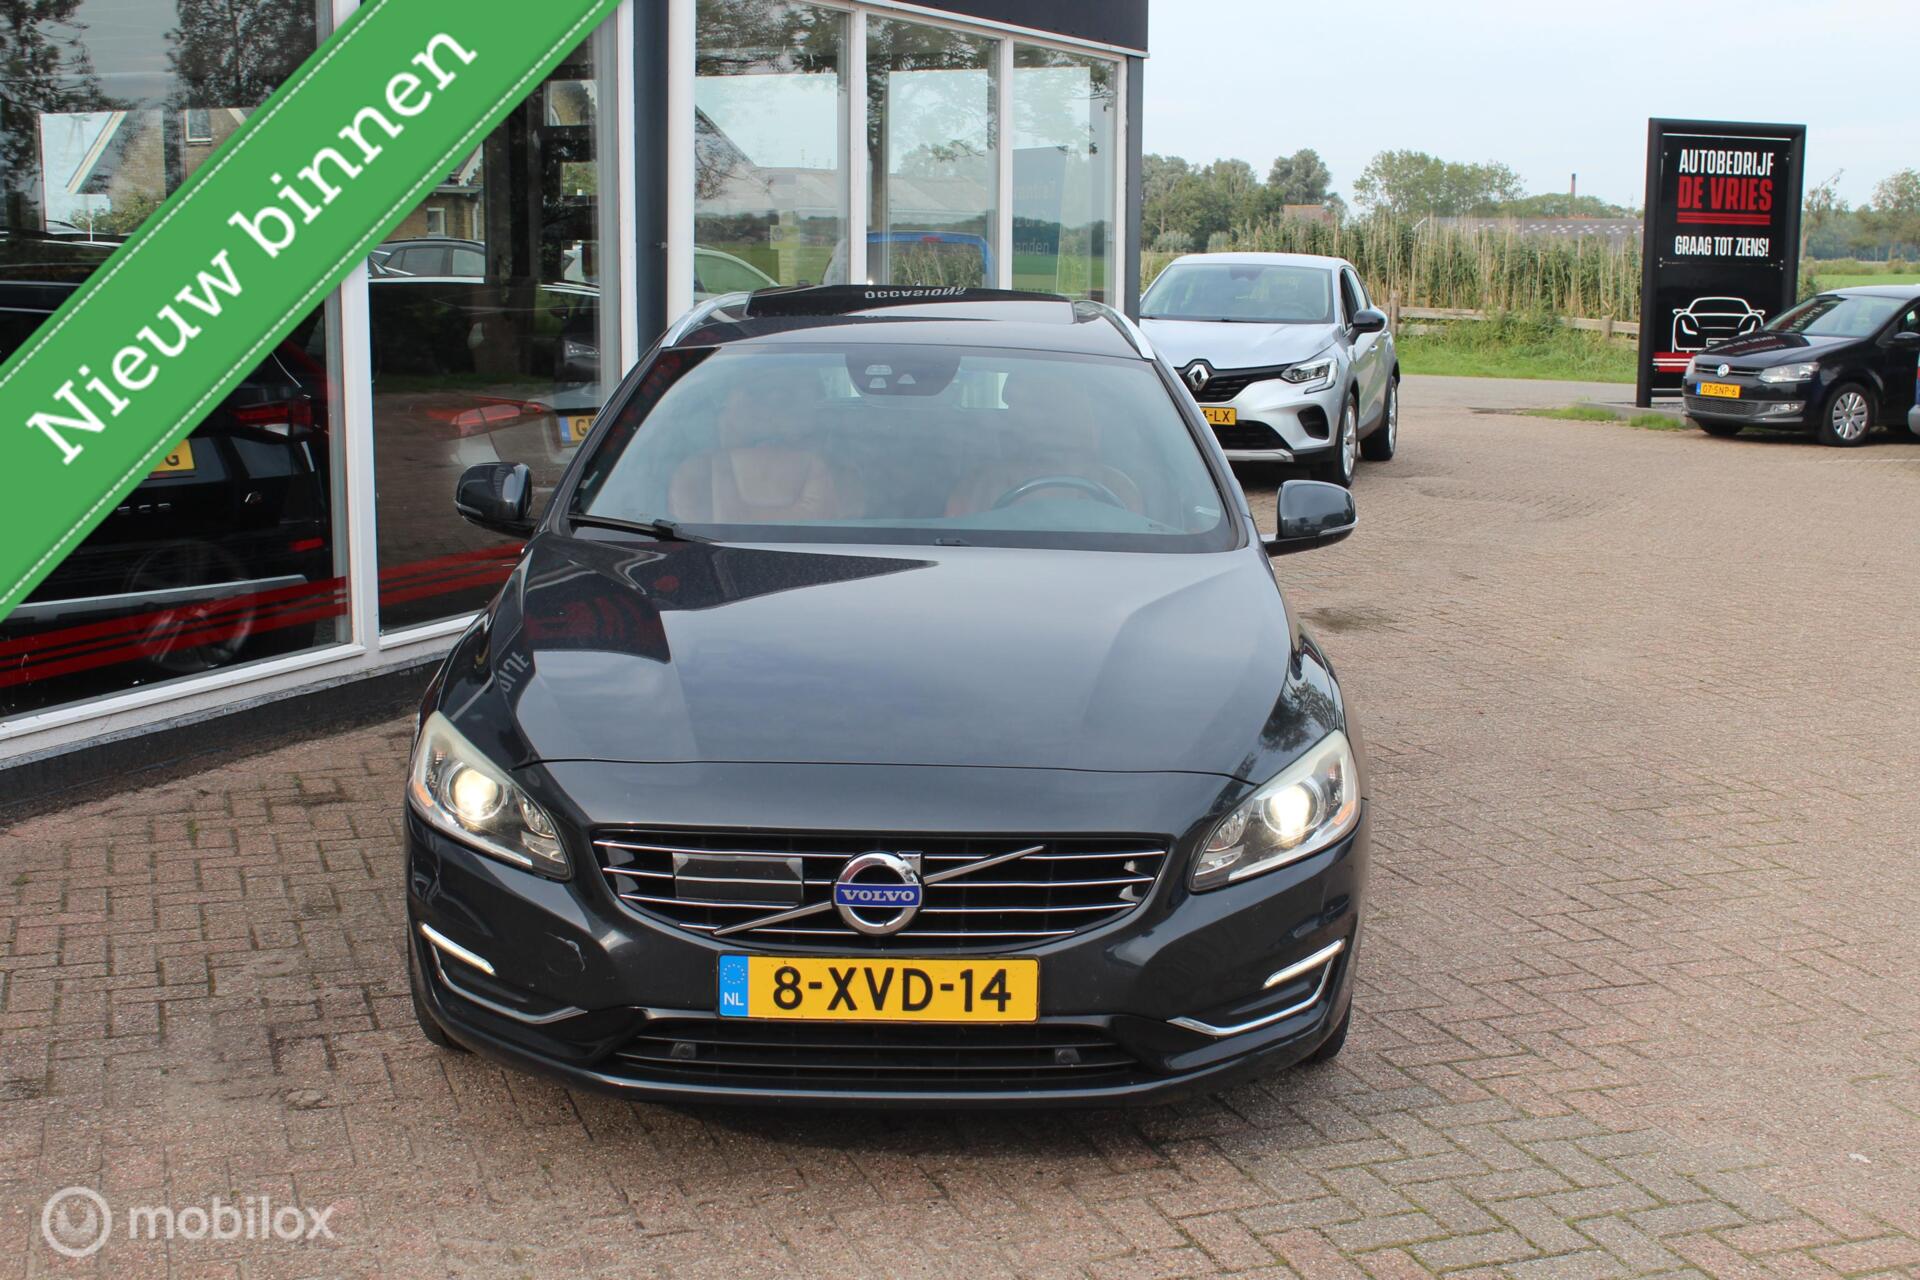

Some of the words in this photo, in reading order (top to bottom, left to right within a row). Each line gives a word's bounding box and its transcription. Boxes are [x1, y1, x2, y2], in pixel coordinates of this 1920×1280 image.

[1679, 149, 1775, 176] AUTOBEDRIJF
[1678, 176, 1704, 209] DE
[1710, 177, 1773, 211] VRIES
[1675, 235, 1712, 256] GRAAG
[1714, 236, 1733, 256] TOT
[1735, 237, 1769, 257] ZIENS!
[841, 889, 915, 901] VOLVO
[724, 992, 744, 1006] NL
[773, 965, 1012, 1013] 8-XVD-14
